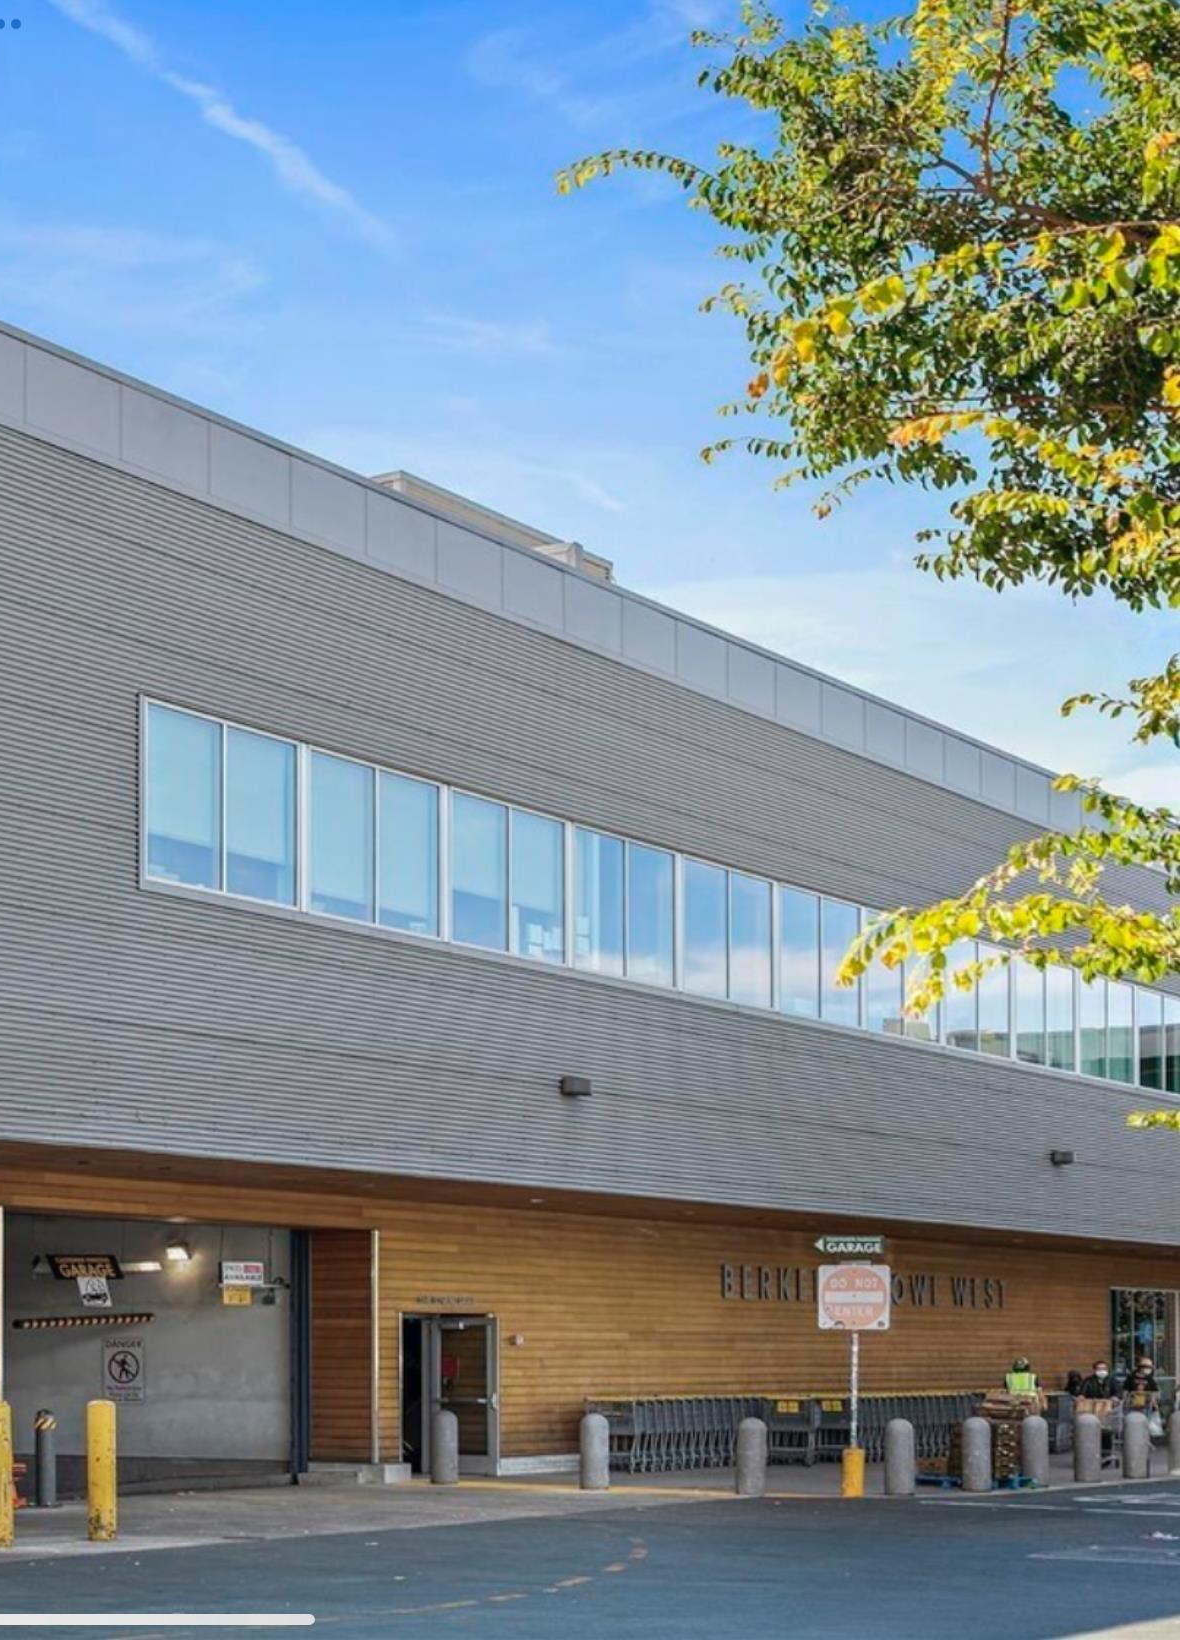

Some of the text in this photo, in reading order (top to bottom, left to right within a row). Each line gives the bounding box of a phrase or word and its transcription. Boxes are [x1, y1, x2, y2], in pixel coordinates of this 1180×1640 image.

[826, 1242, 884, 1253] GARAGE
[59, 1263, 117, 1278] GARAGE
[721, 1264, 1007, 1309] BERKE OWL WEST
[830, 1277, 879, 1289] DO NOT
[834, 1305, 874, 1317] ENTER
[105, 1339, 141, 1348] DANGER
